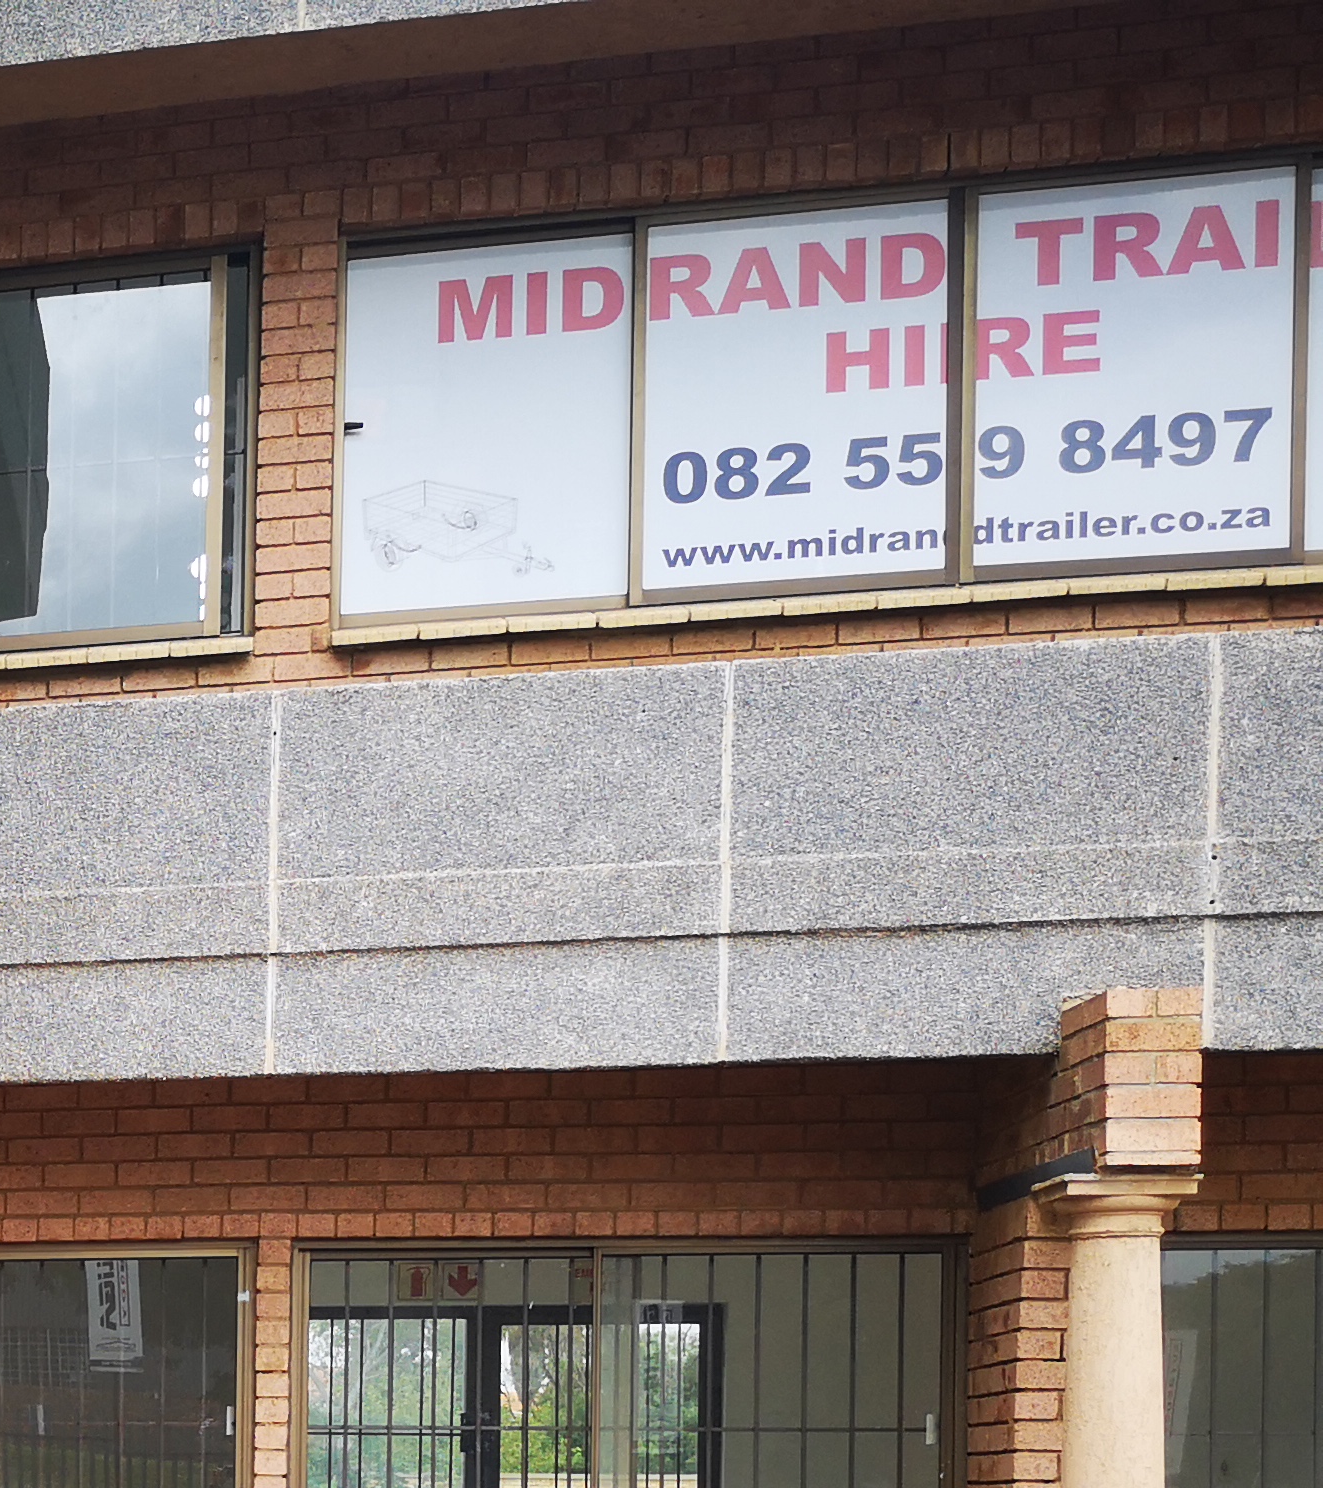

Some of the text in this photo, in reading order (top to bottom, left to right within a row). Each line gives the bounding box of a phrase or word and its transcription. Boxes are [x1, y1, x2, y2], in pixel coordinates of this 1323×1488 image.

[438, 199, 1323, 344] MIDRAND TRAI
[825, 310, 1102, 394] HIRE
[662, 407, 1273, 504] 082 559 8497
[662, 501, 1272, 569] www.midrandtrailer.co.za
